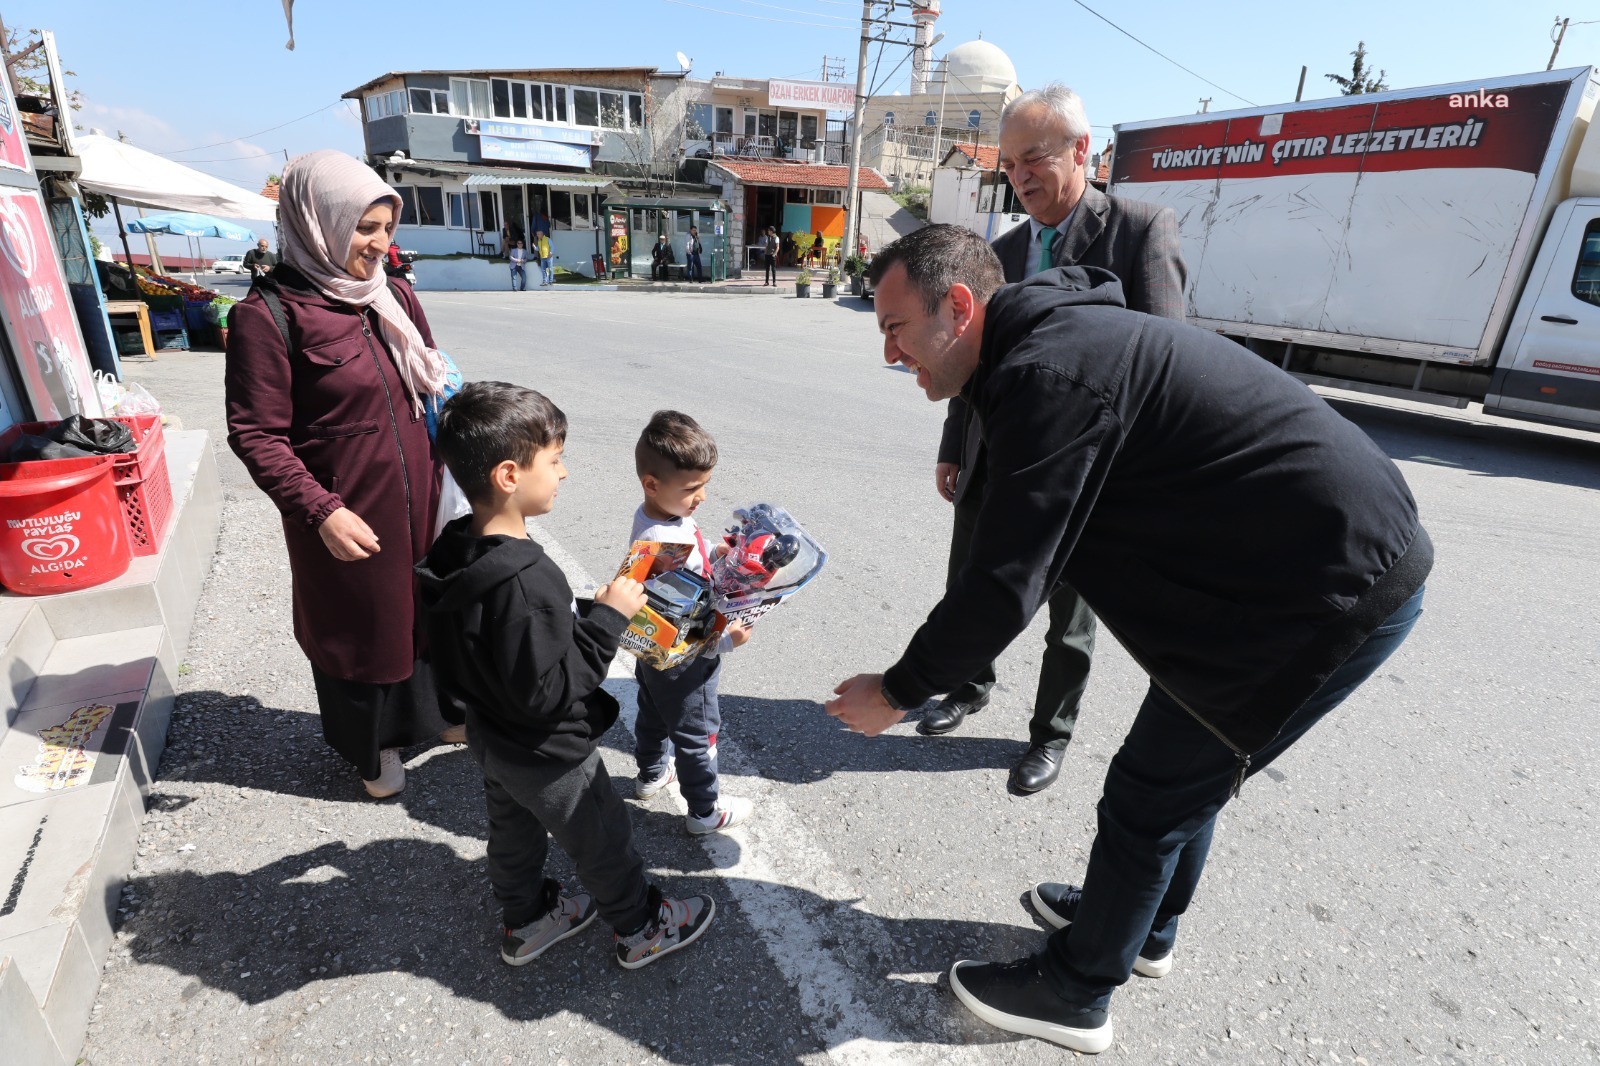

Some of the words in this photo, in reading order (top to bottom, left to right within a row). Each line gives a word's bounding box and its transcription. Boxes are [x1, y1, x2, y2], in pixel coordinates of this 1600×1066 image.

[793, 86, 820, 101] ERKEK
[1271, 134, 1327, 166] ÇITIR
[1330, 118, 1485, 156] LEZZETLERİ!
